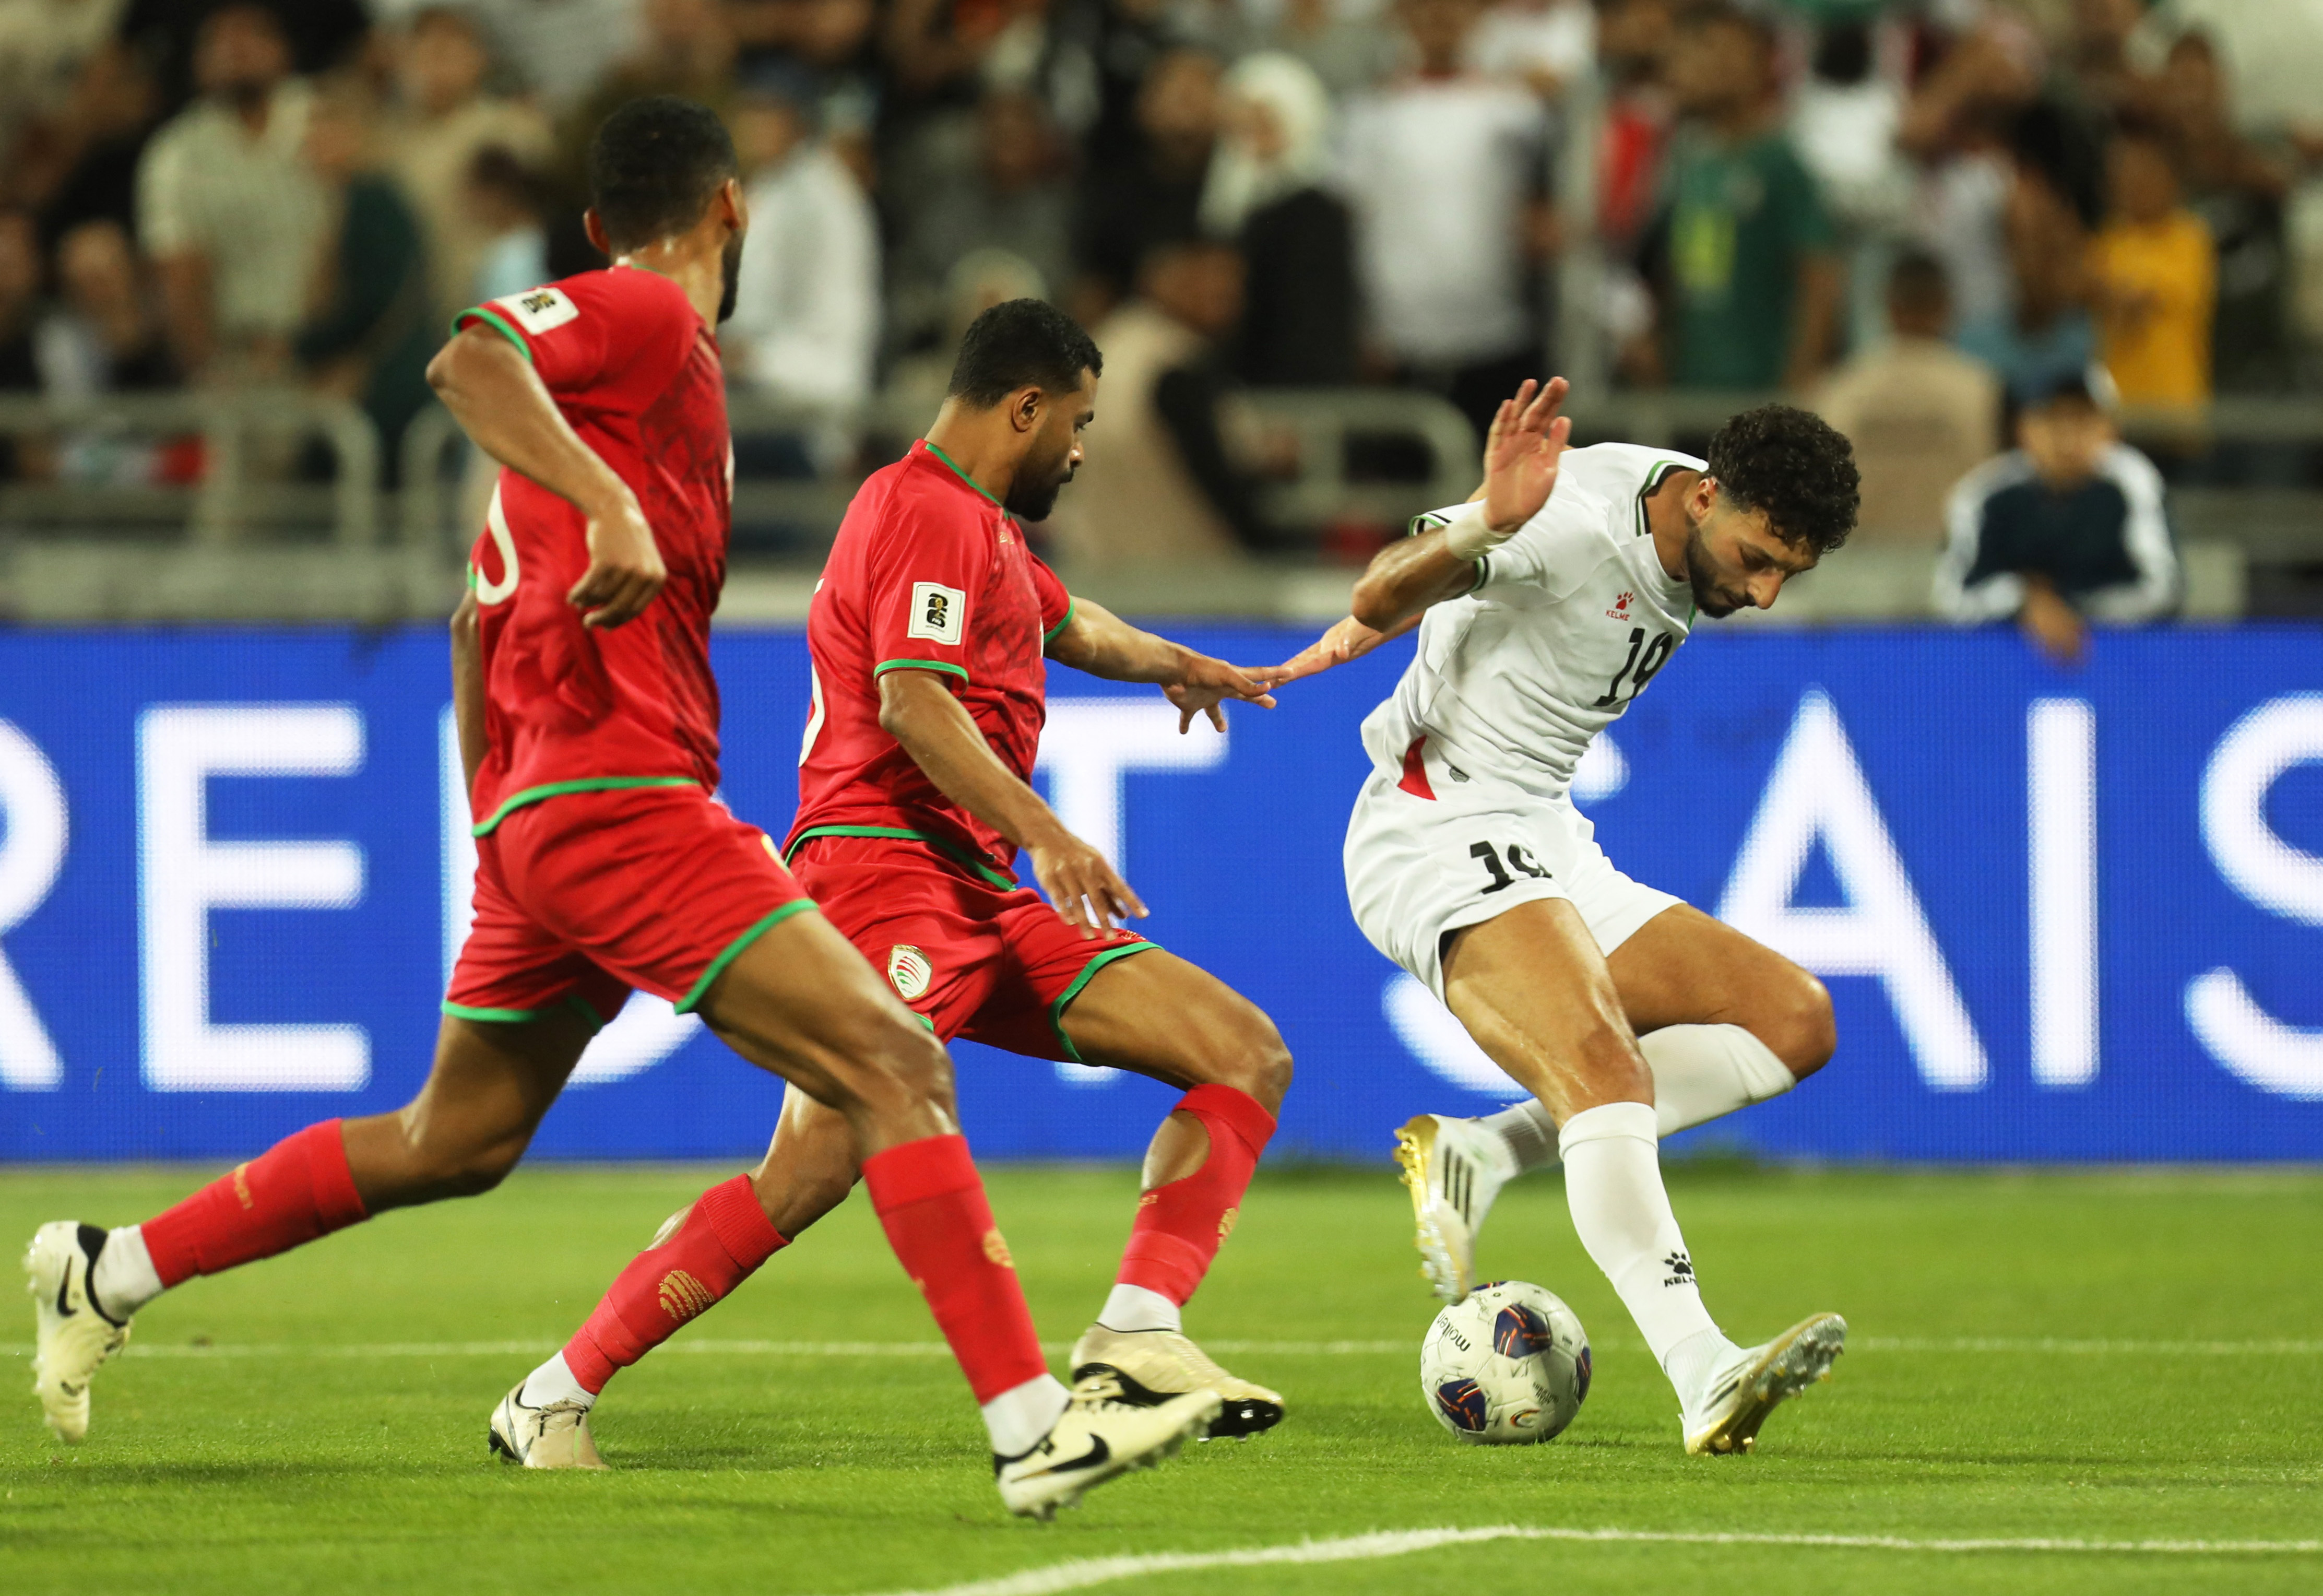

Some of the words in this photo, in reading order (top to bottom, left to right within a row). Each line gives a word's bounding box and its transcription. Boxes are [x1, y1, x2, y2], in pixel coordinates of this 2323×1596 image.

[1606, 609, 1630, 621] KELME
[1594, 628, 1673, 707] 19
[1437, 1313, 1471, 1352] molten
